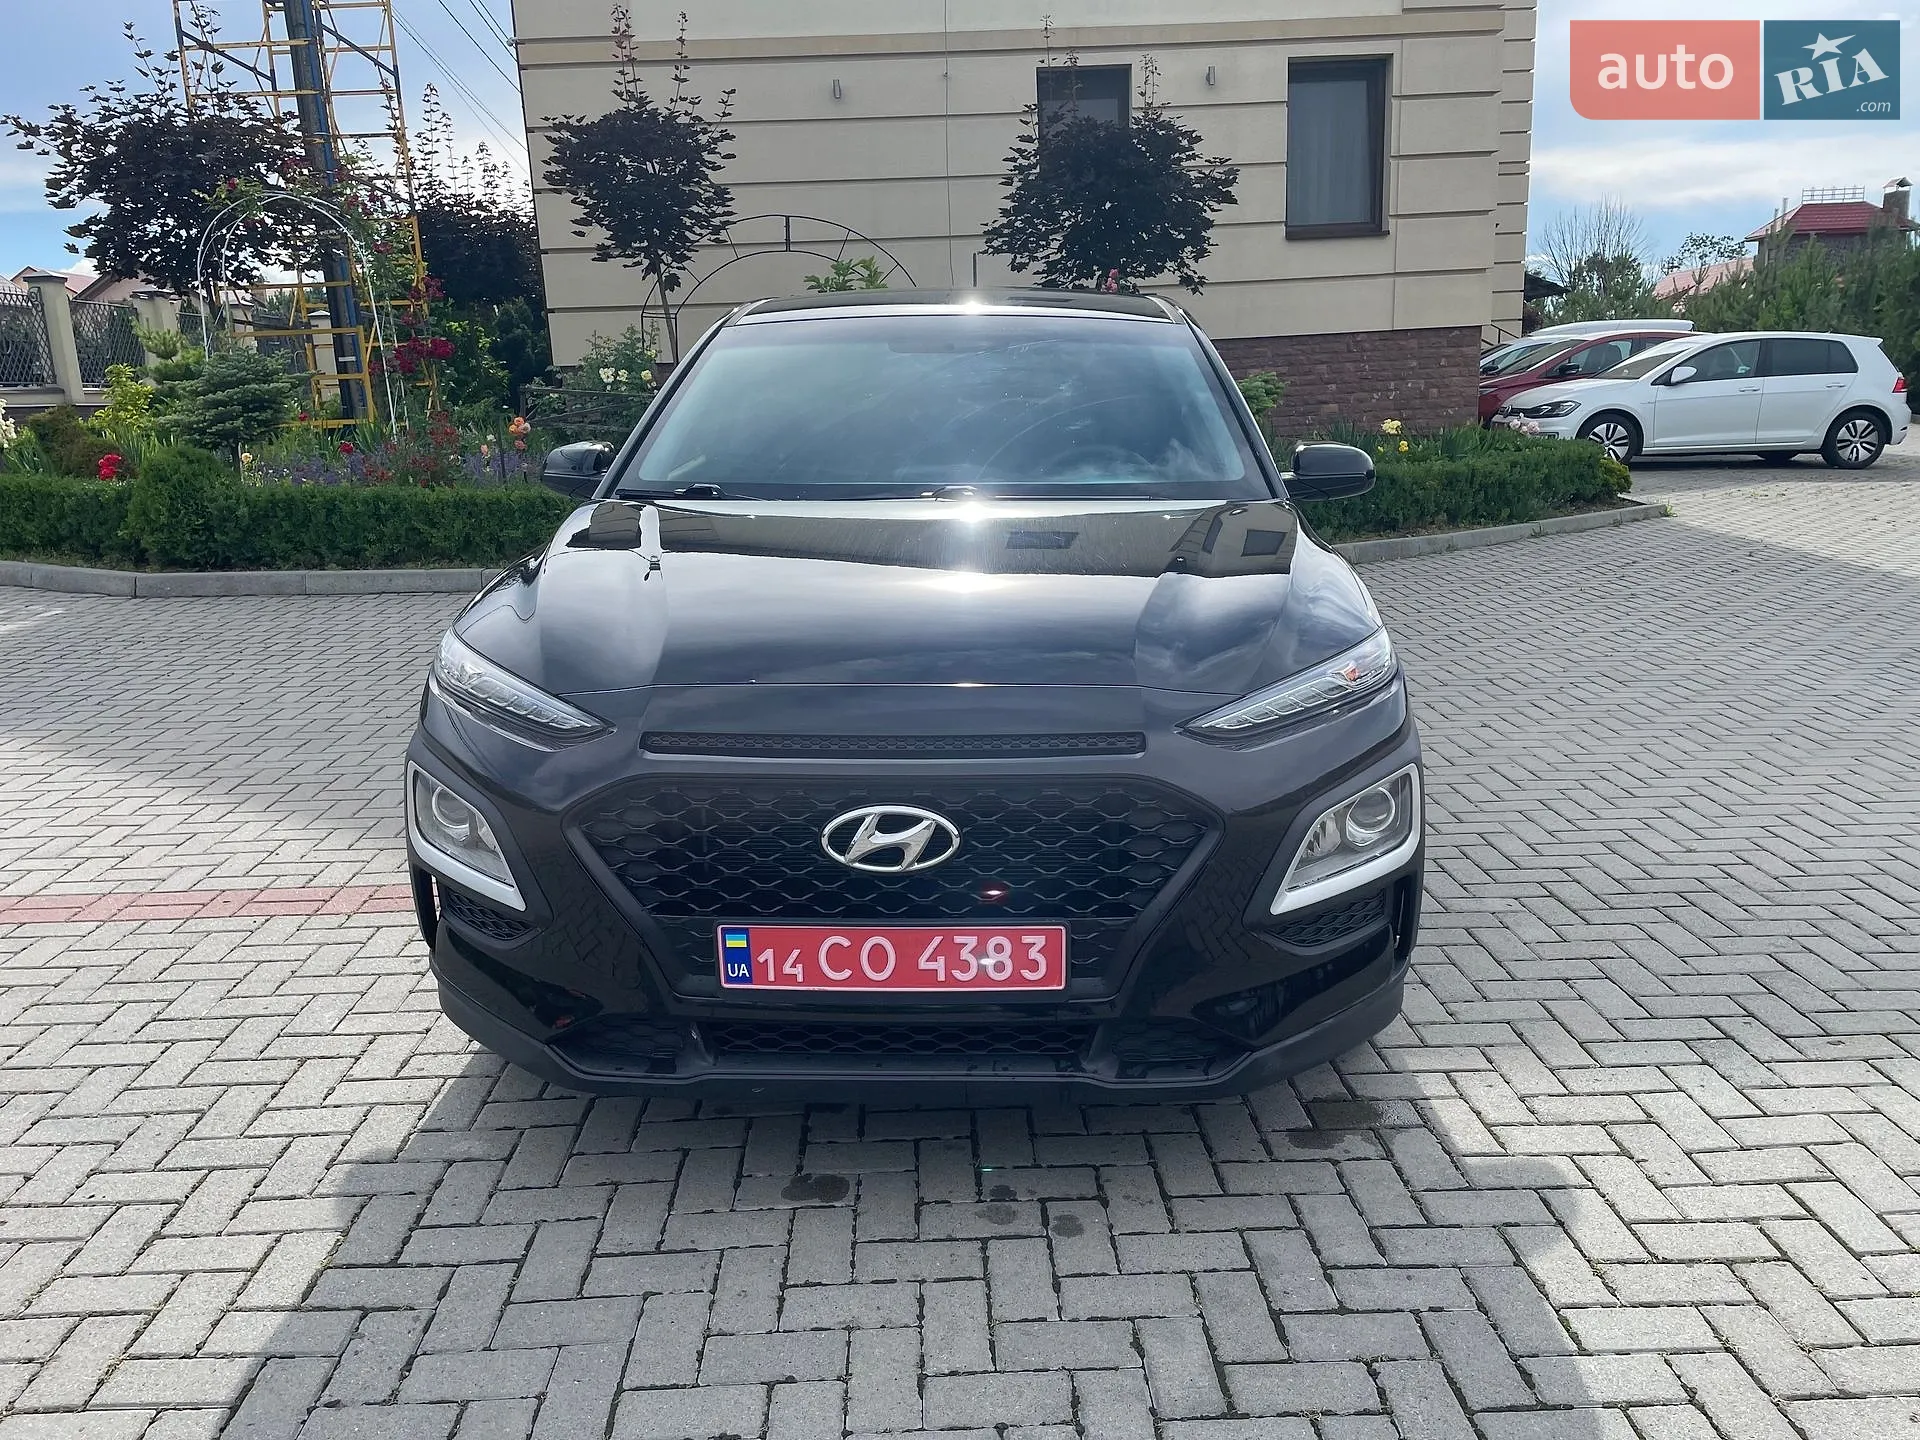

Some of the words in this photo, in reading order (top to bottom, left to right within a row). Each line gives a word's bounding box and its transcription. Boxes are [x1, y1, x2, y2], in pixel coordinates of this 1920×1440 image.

[727, 963, 750, 978] UA
[756, 948, 804, 983] 14
[818, 935, 896, 981] CO
[917, 935, 1047, 982] 4383
